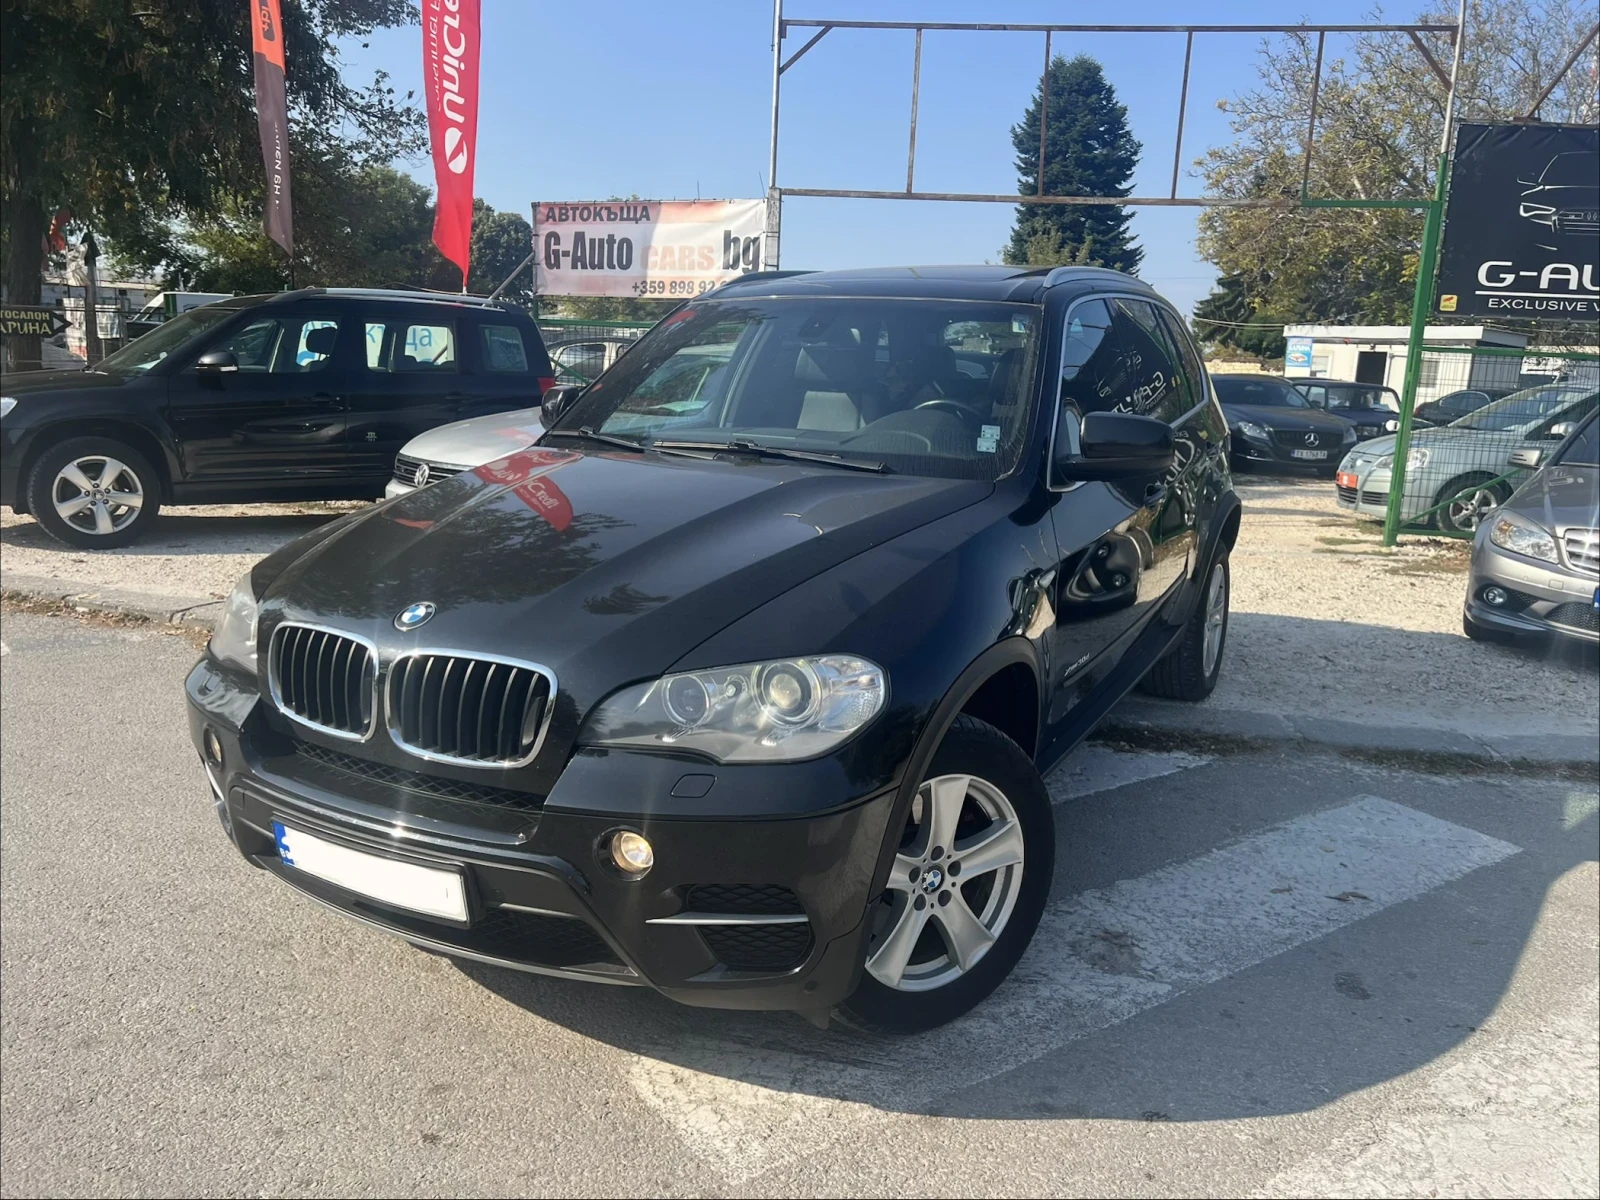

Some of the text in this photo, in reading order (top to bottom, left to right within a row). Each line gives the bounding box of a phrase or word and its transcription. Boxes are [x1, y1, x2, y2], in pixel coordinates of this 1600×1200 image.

[545, 204, 651, 224] АВТОКЪЩА
[544, 230, 760, 274] G-Auto CARS bg
[632, 280, 666, 295] +359
[669, 280, 695, 295] 898
[1488, 298, 1588, 312] EXCLUSIVE
